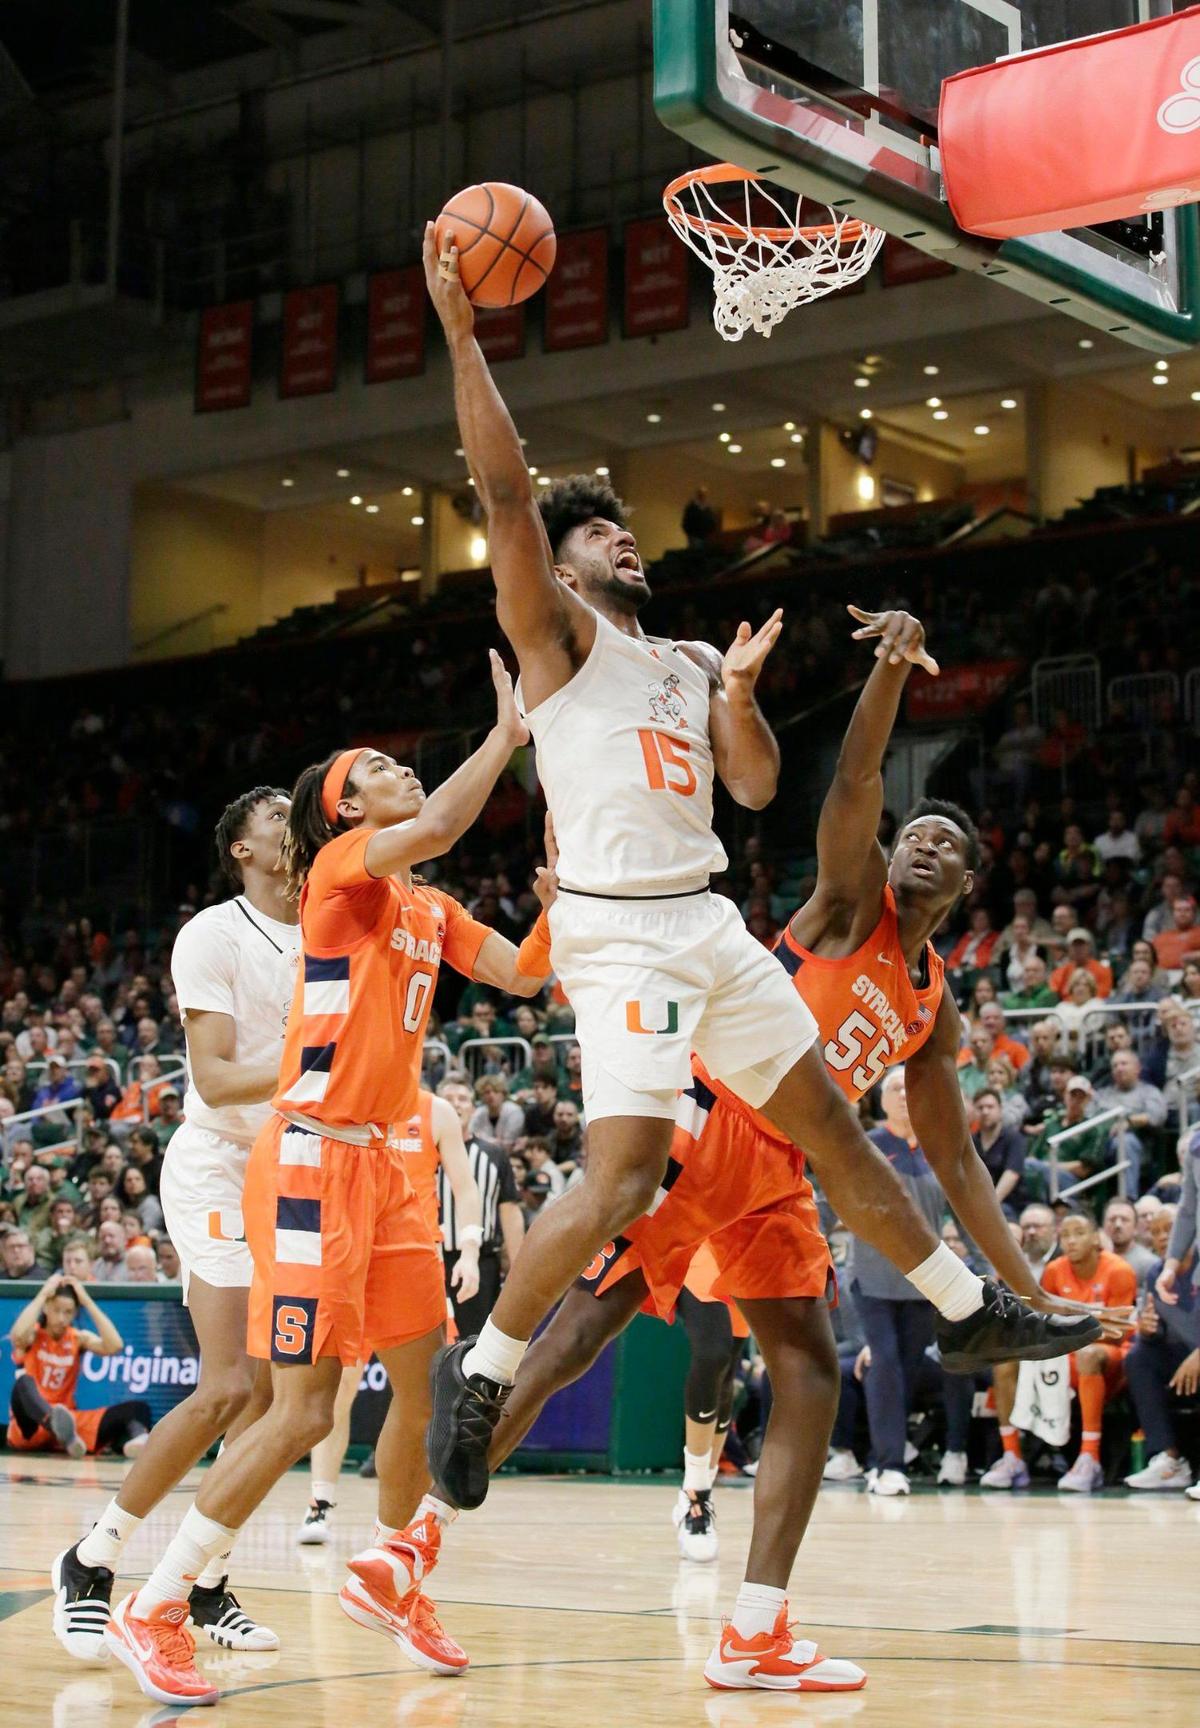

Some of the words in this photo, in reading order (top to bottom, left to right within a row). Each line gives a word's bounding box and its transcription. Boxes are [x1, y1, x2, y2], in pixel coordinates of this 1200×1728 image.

[637, 728, 697, 796] 15
[402, 970, 432, 1034] 0
[626, 1000, 678, 1034] U
[824, 1008, 892, 1092] 55
[275, 1304, 309, 1356] S
[41, 1365, 66, 1390] 13
[82, 1345, 202, 1393] Origina
